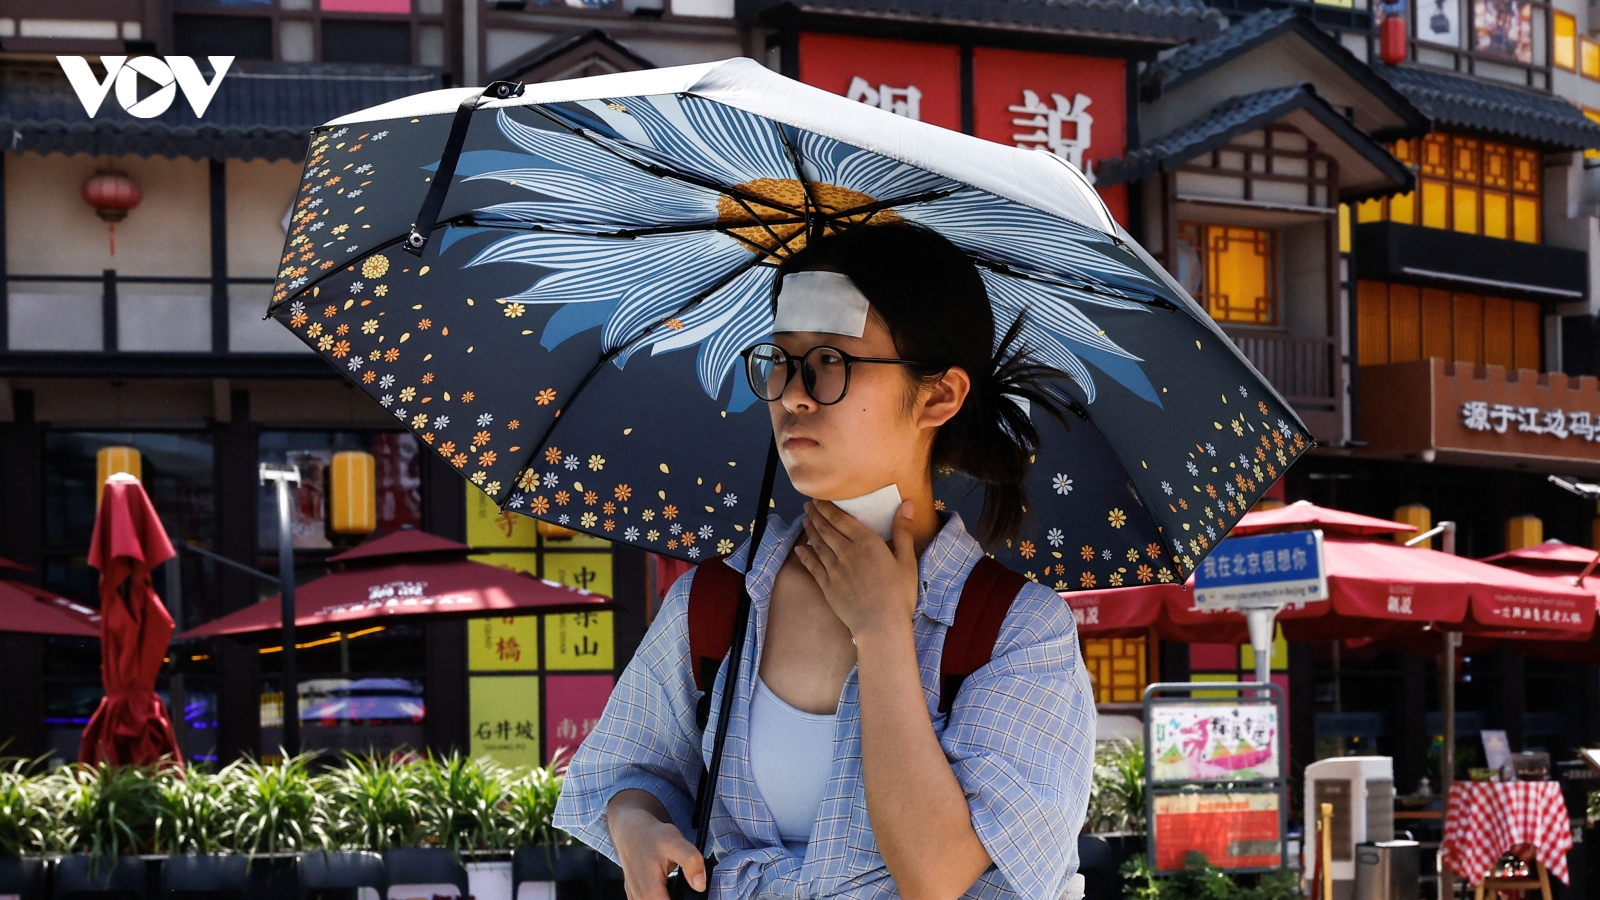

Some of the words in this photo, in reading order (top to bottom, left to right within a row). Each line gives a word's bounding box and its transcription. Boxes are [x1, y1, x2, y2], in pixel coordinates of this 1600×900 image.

[1462, 401, 1600, 442] 源于江边码
[1203, 547, 1307, 578] 我在北京很想你
[474, 718, 535, 741] 石井坡
